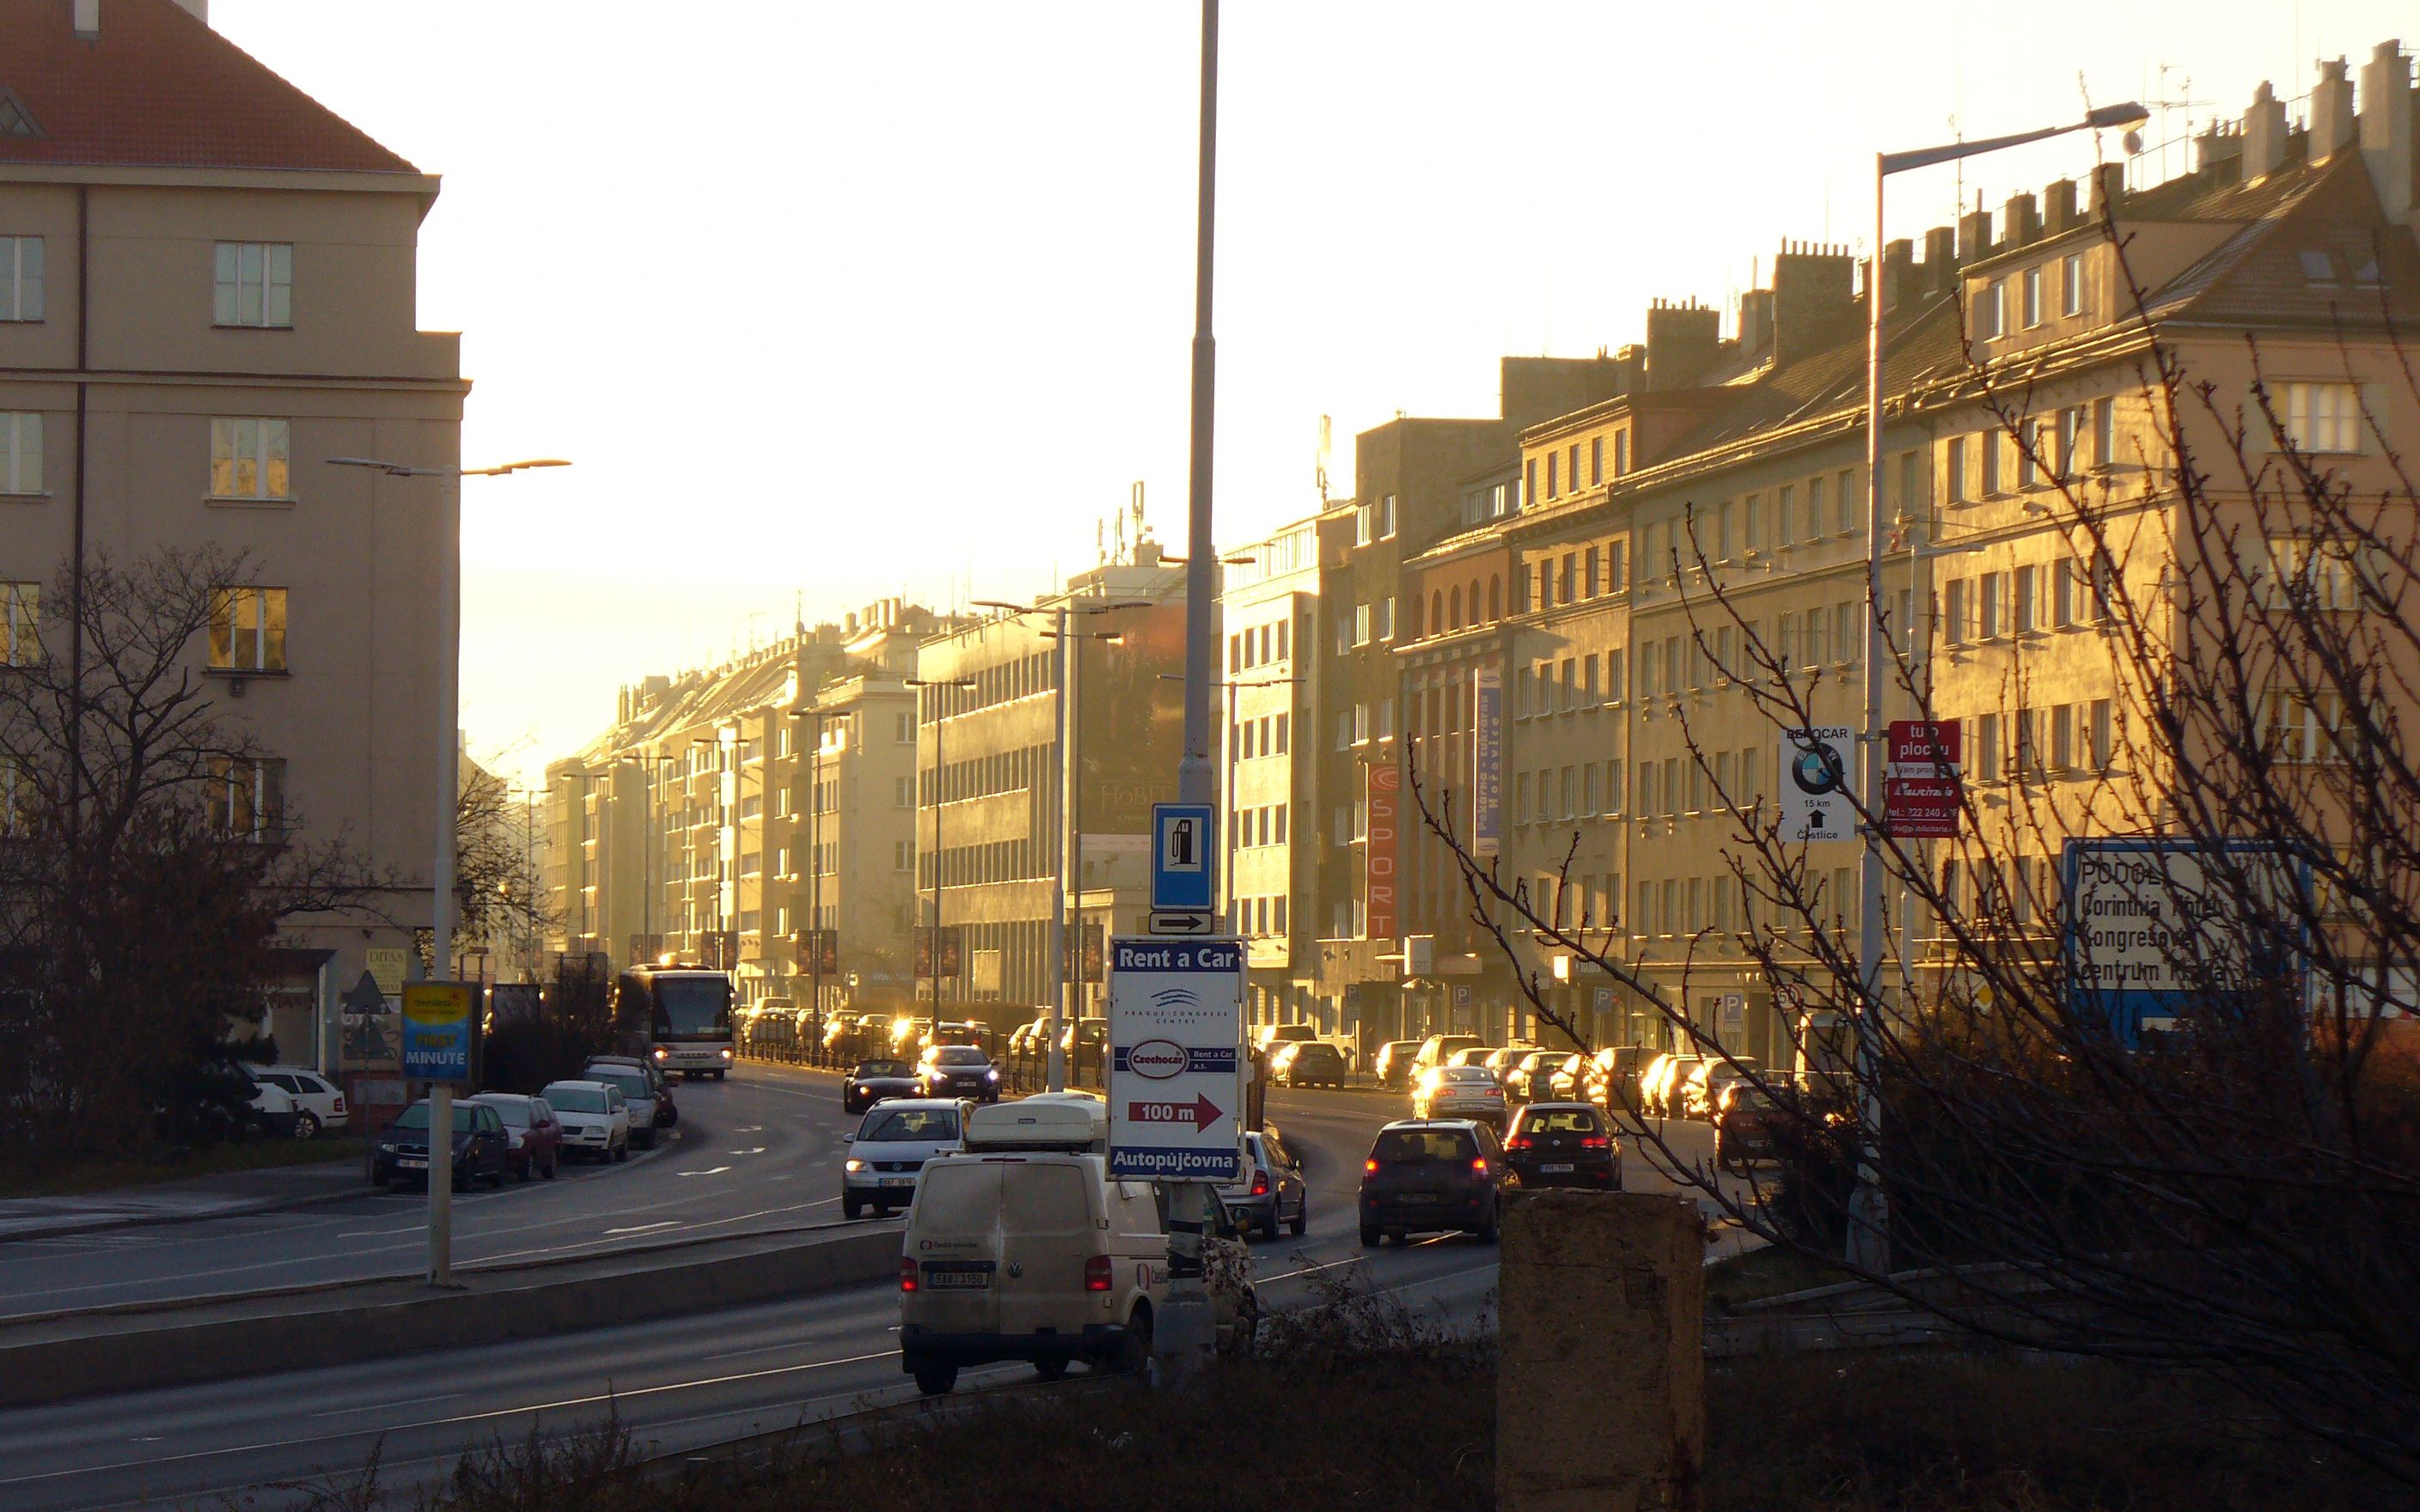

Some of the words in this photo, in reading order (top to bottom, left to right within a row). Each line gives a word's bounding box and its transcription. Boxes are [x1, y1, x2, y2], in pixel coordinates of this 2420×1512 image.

[1910, 724, 1939, 738] tuo
[1900, 741, 1949, 759] plocu
[1805, 799, 1814, 808] 15
[1818, 799, 1830, 808] km
[1925, 808, 1940, 817] 240
[1372, 799, 1393, 934] SPORT
[1120, 948, 1170, 967] Rent
[1177, 952, 1189, 967] a
[1197, 948, 1234, 967] Car
[1458, 989, 1468, 1002] P
[1598, 991, 1609, 1005] P
[1727, 997, 1739, 1013] P
[406, 1051, 466, 1065] MINUTE
[1134, 1054, 1183, 1064] Czechocar
[1142, 1104, 1173, 1120] 100
[1178, 1107, 1195, 1120] m
[1113, 1150, 1233, 1172] Autopůjčovna
